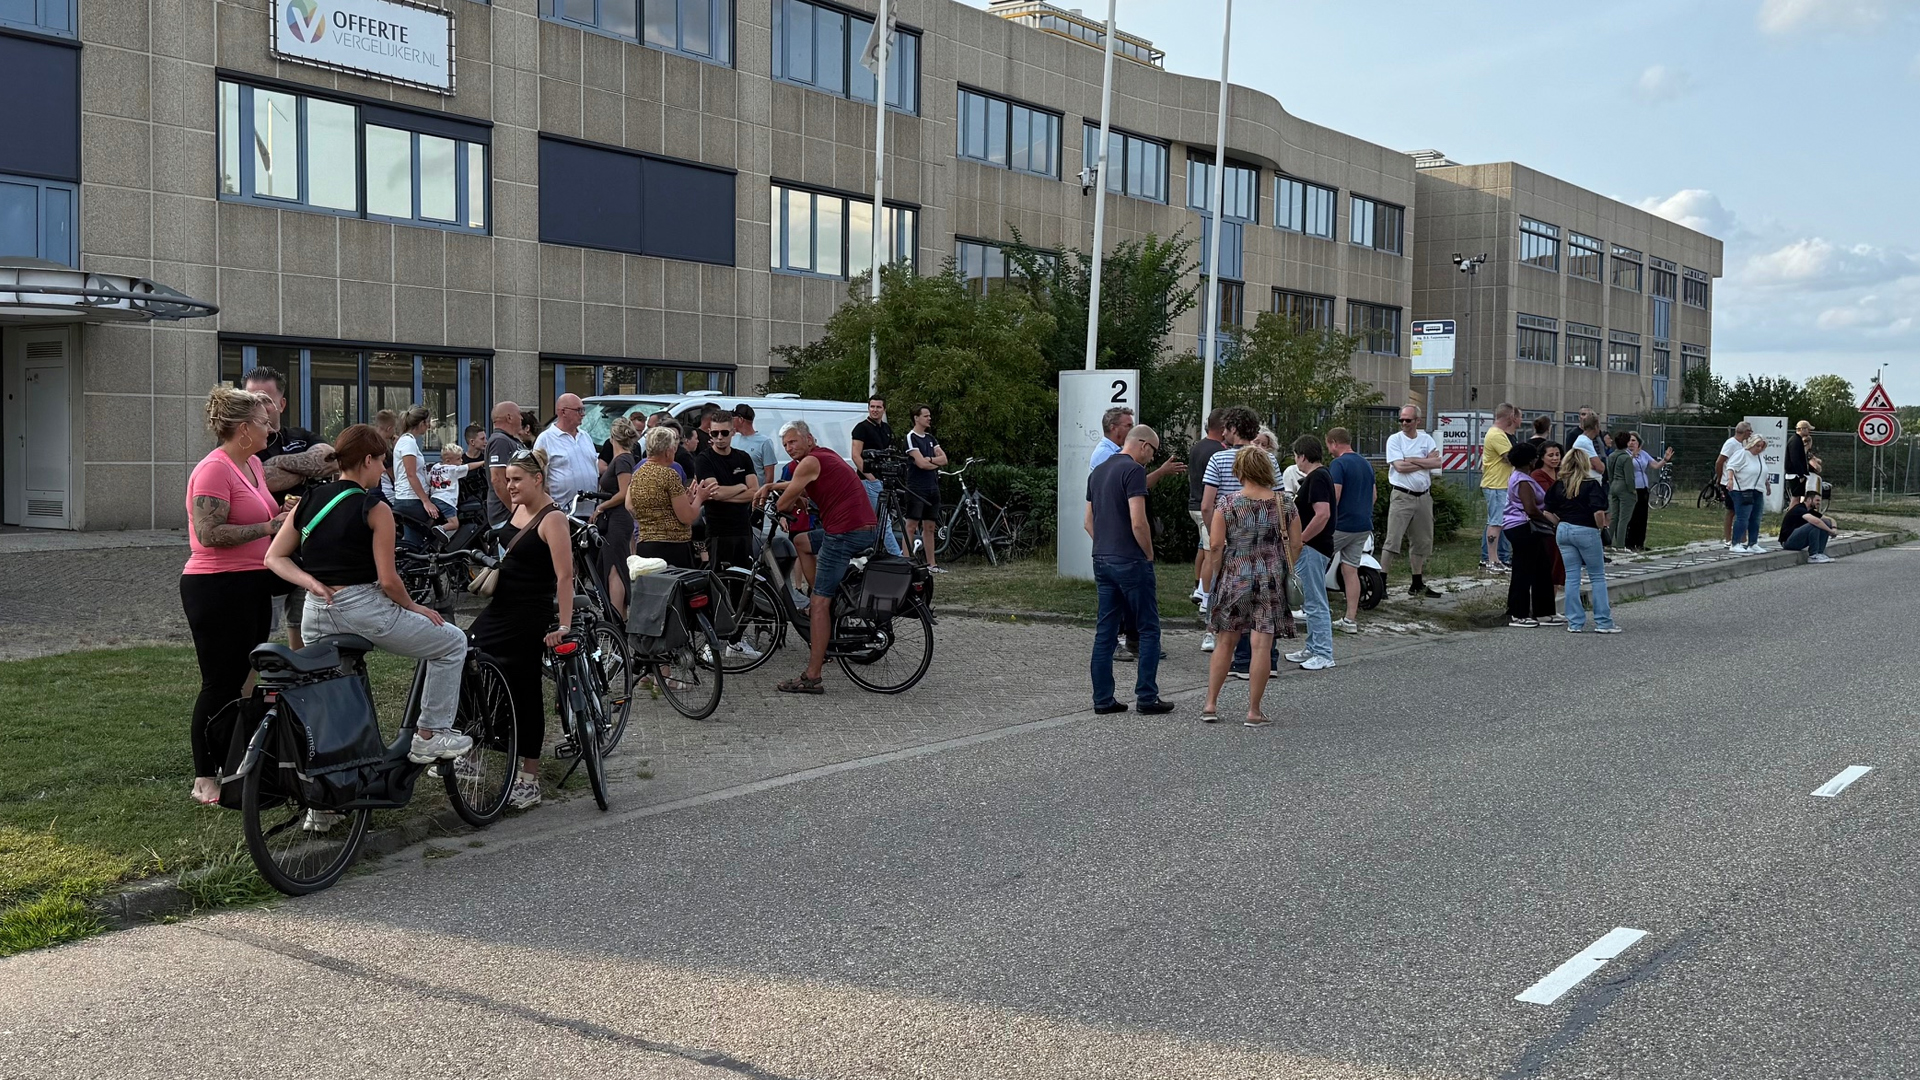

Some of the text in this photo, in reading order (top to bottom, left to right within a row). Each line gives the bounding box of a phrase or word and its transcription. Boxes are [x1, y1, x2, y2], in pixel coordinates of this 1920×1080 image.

[333, 10, 409, 44] OFFERTE
[332, 30, 440, 67] VERGELIJKER.NL
[1111, 379, 1128, 403] 2
[1775, 420, 1783, 429] 4
[1864, 423, 1888, 435] 30
